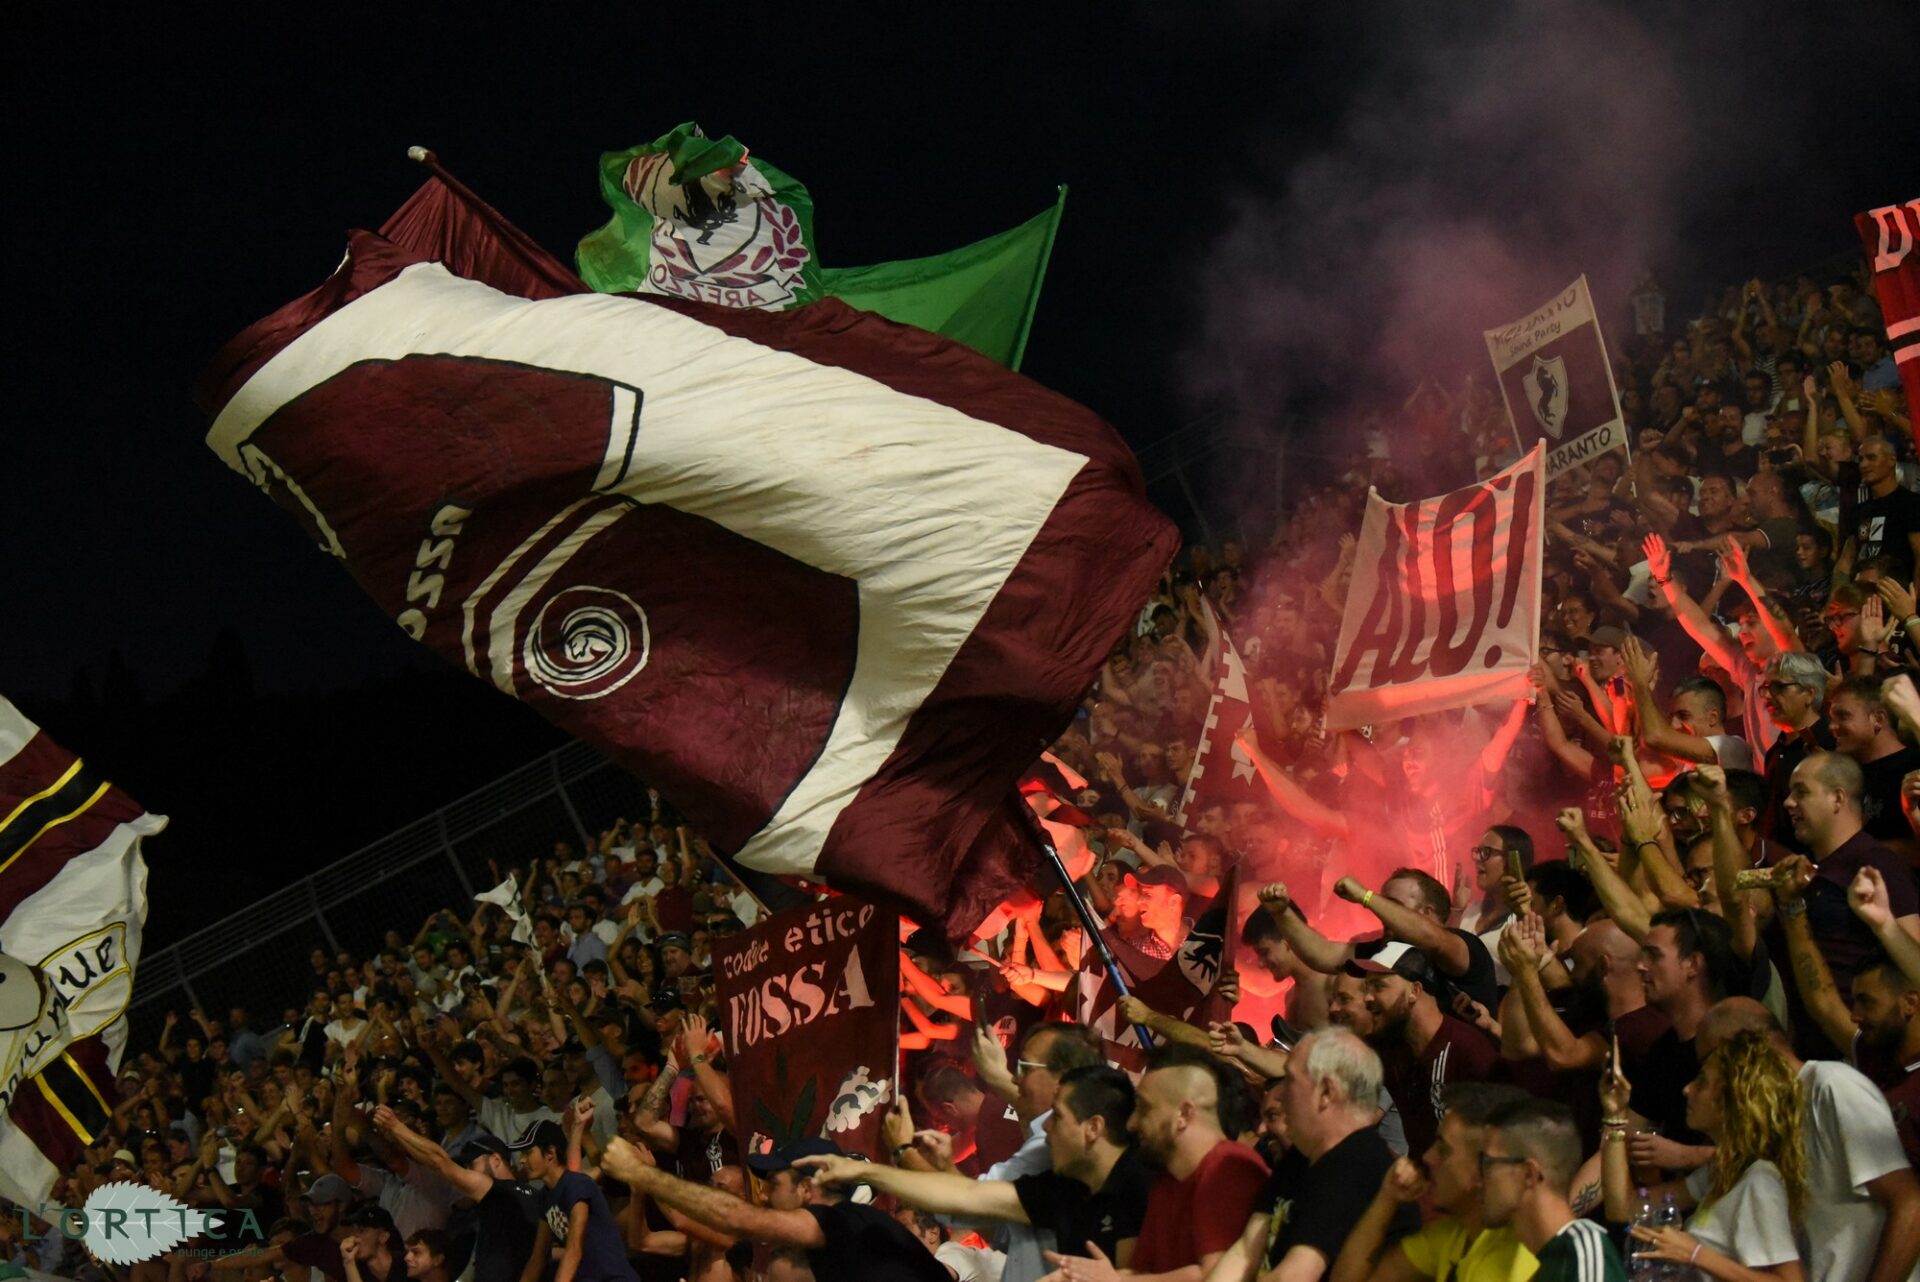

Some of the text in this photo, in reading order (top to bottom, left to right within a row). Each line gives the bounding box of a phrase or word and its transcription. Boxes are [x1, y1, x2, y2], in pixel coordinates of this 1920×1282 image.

[1534, 321, 1561, 342] Party
[1546, 427, 1611, 475] ARANTO
[784, 904, 876, 953] etico
[729, 944, 876, 1055] FOSSA
